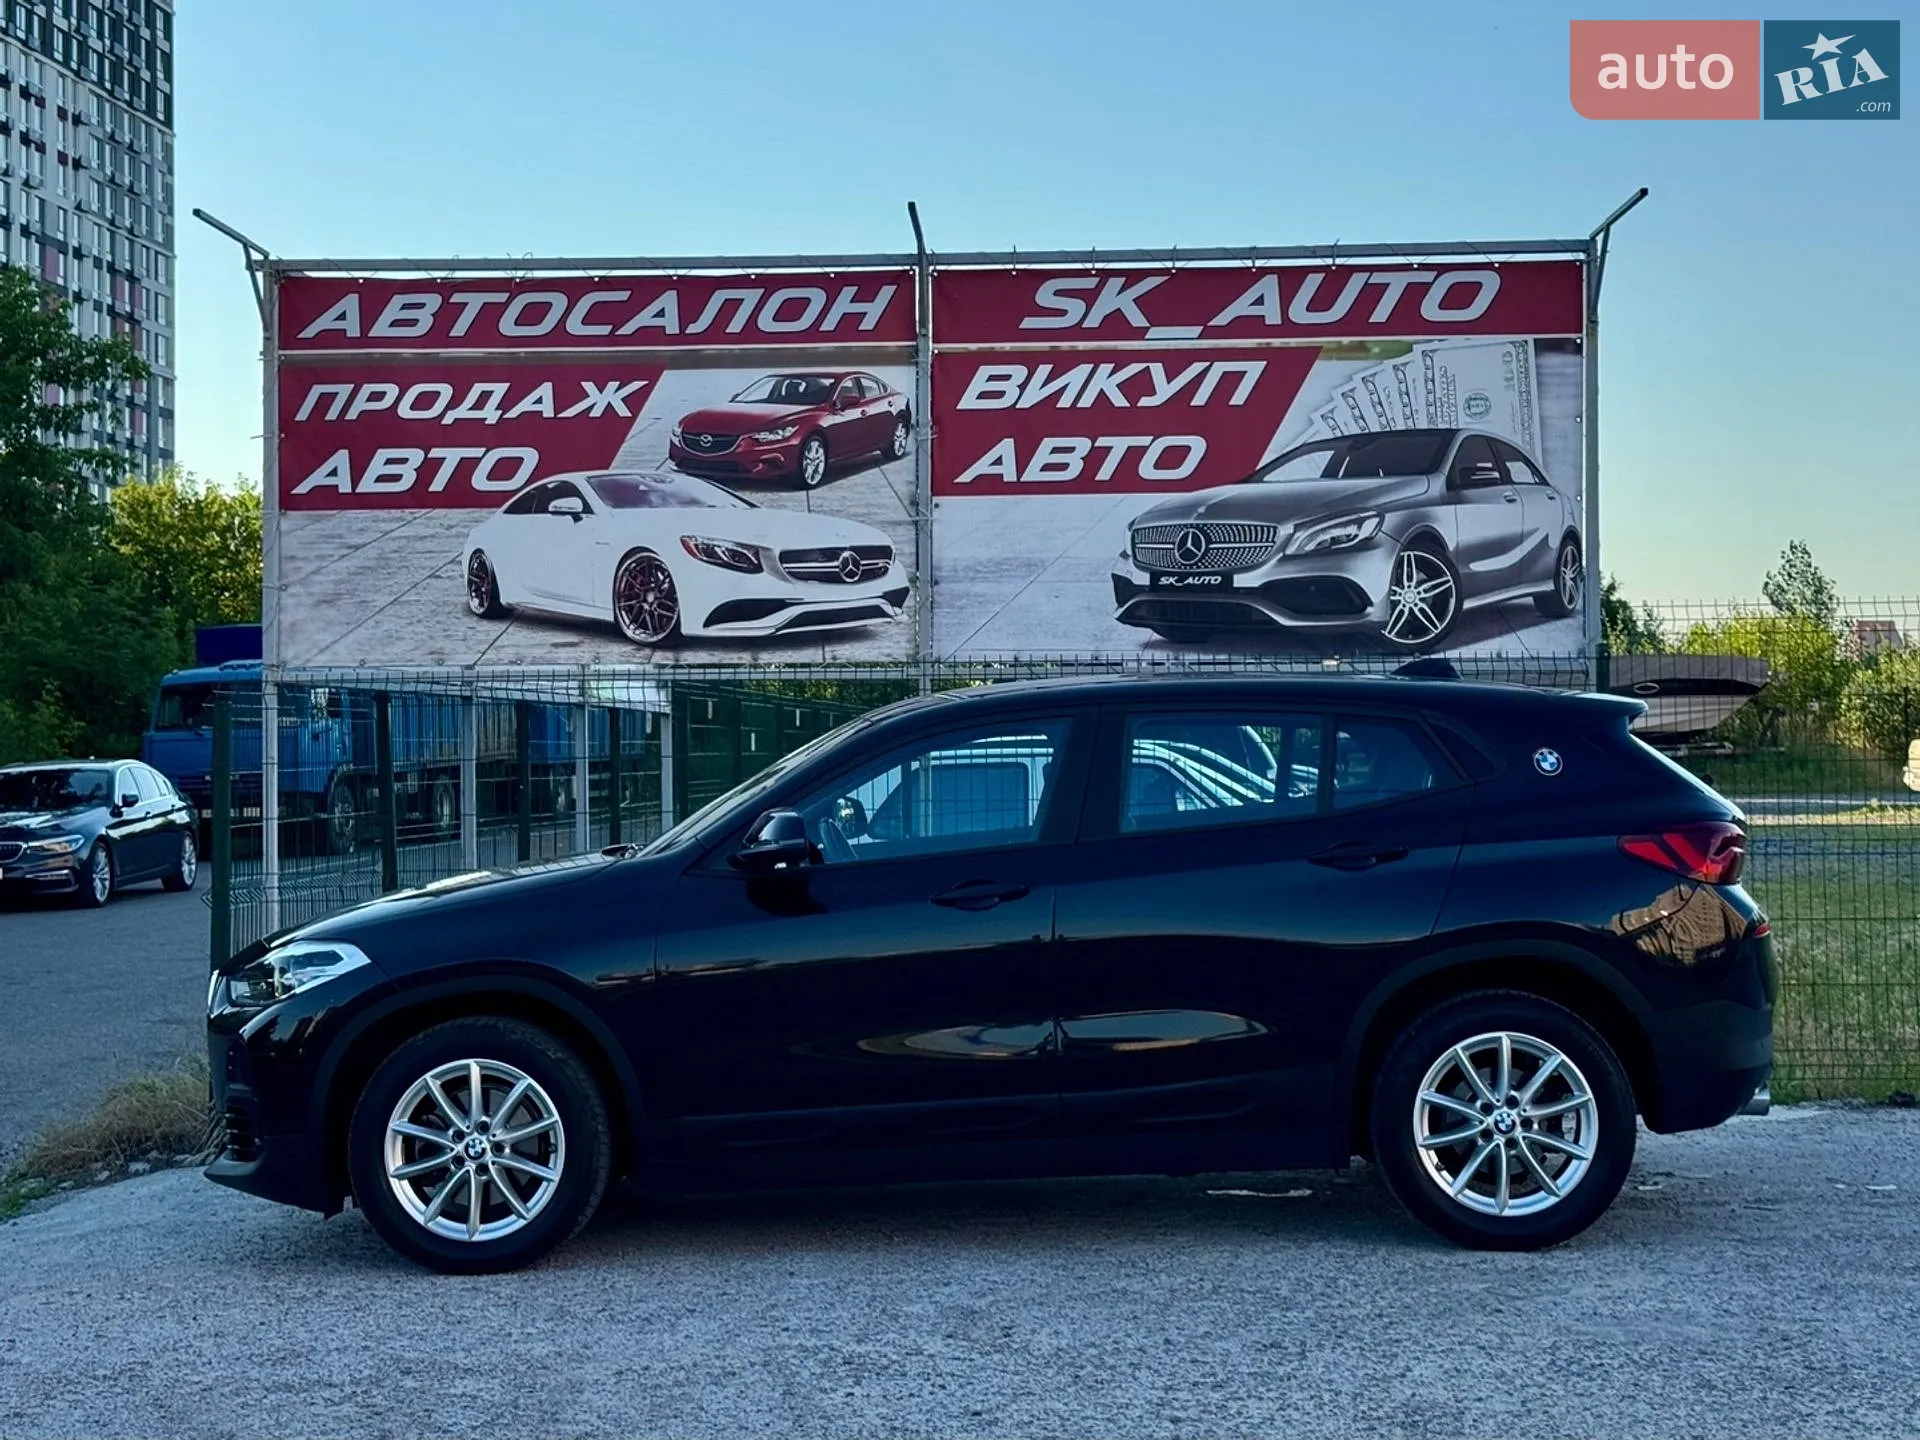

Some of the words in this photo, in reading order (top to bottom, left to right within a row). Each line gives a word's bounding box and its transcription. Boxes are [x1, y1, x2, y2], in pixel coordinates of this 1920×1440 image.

[297, 284, 898, 340] АВТОСАЛОН
[1018, 269, 1502, 340] SK_AUTO
[294, 380, 650, 425] ПРОДАЖ
[956, 360, 1268, 411] ВИКУП
[291, 446, 540, 495] АВТО
[954, 434, 1208, 484] АВТО
[1158, 575, 1222, 586] SK_AUTO
